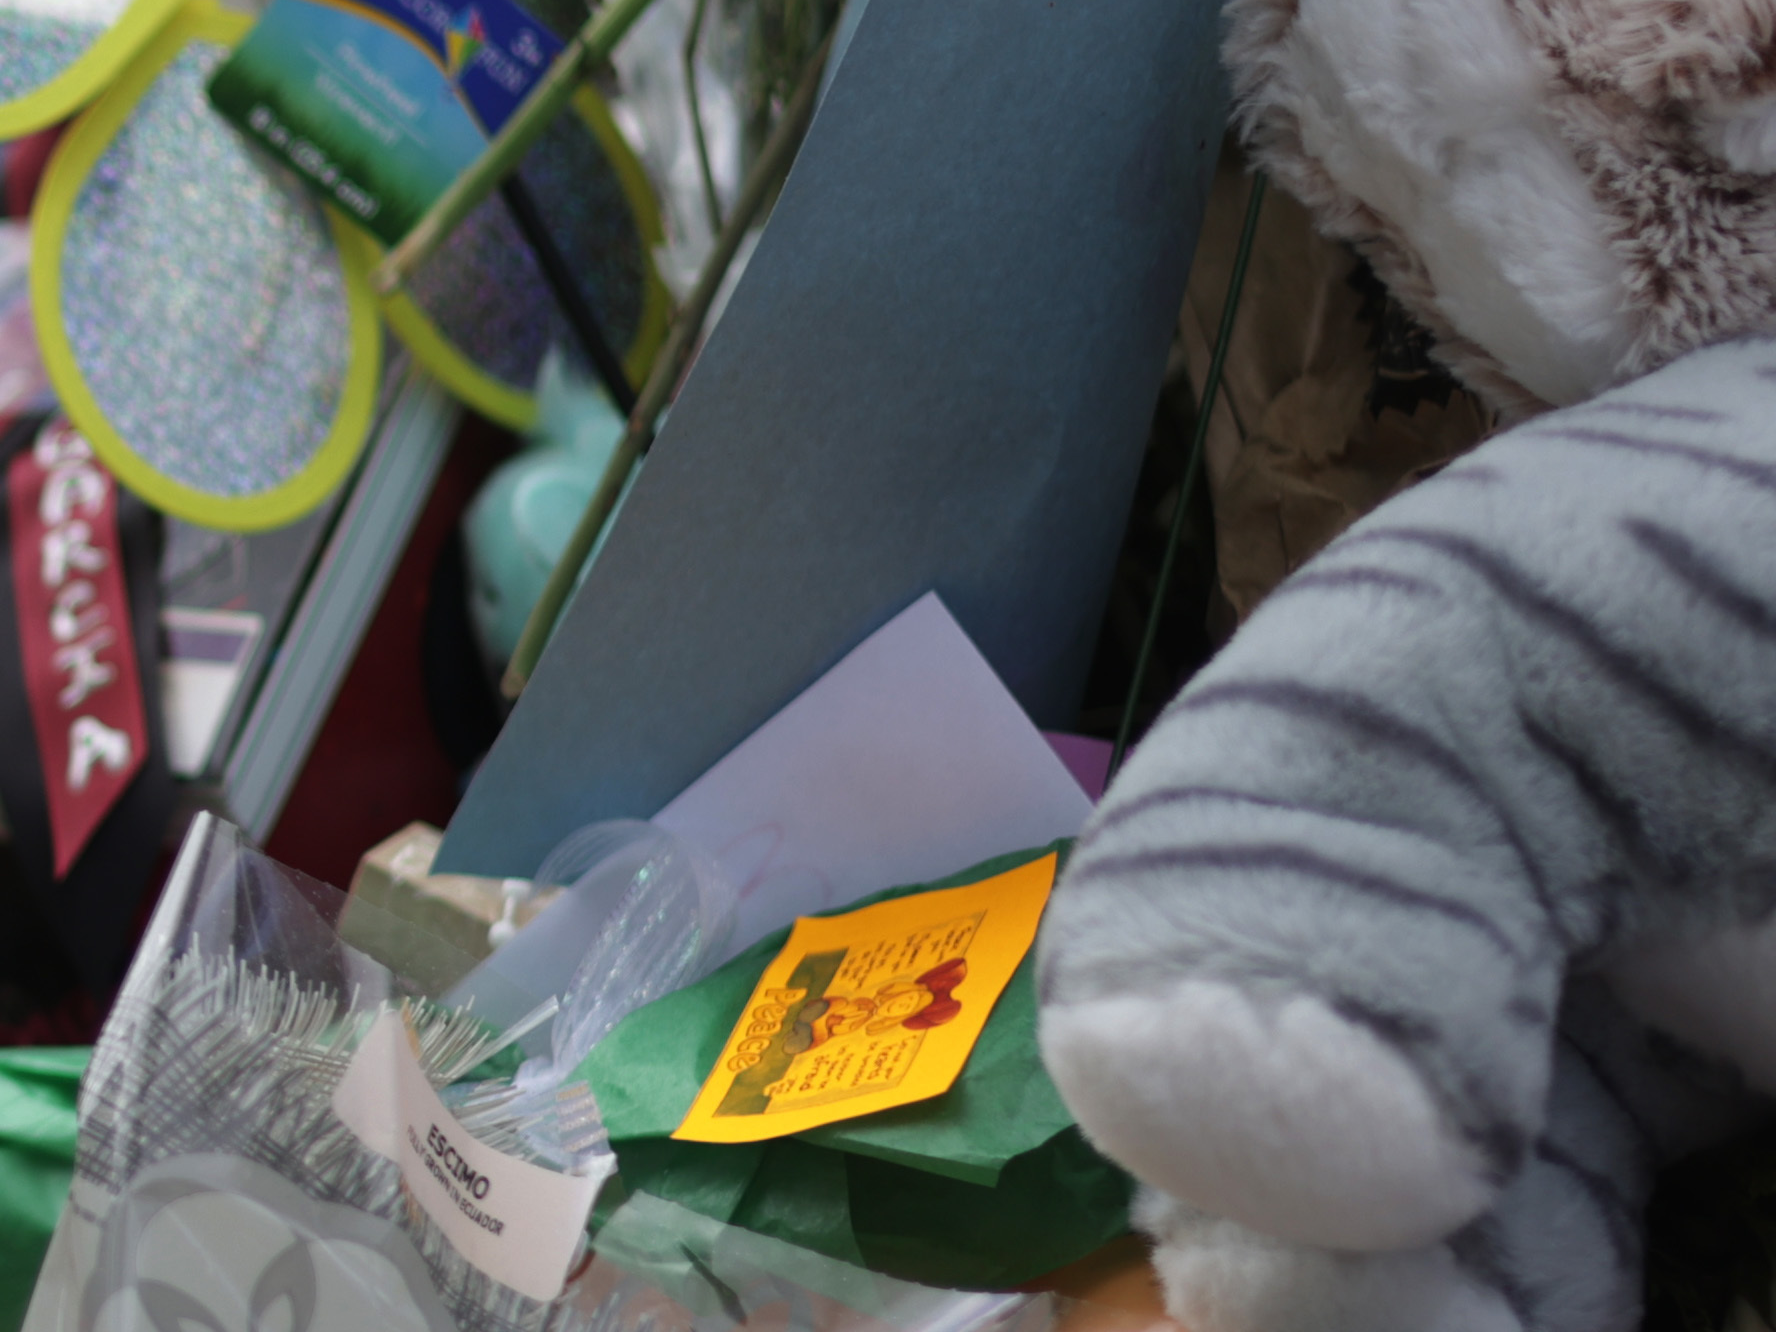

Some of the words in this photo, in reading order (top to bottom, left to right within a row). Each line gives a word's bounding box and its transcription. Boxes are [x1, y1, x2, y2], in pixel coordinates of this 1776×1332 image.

[727, 987, 807, 1073] Peace
[426, 1122, 490, 1201] ESCIMO
[458, 1197, 505, 1237] ECUADOR
